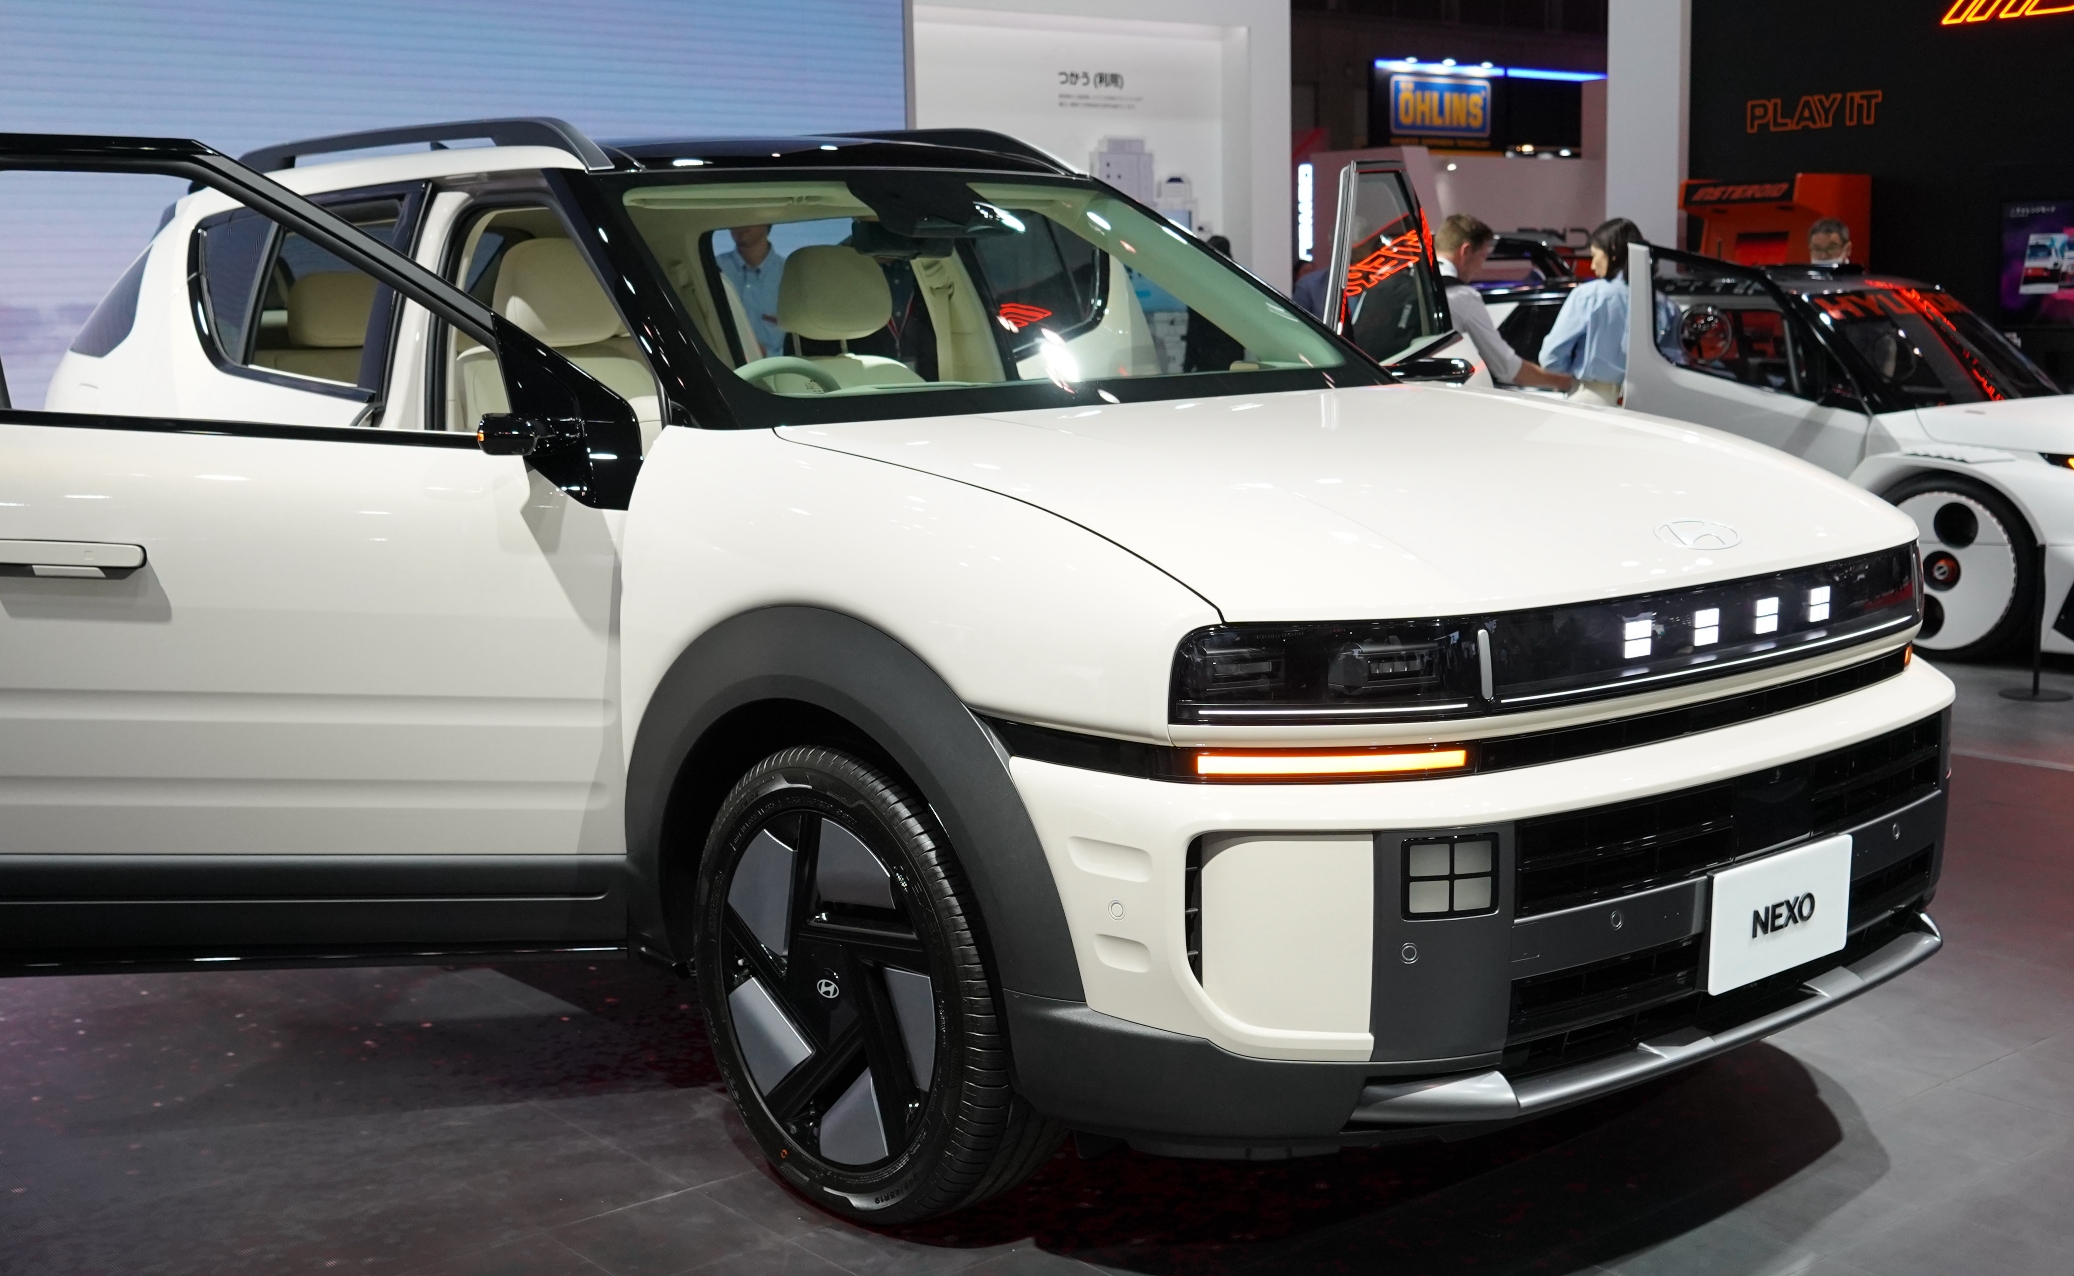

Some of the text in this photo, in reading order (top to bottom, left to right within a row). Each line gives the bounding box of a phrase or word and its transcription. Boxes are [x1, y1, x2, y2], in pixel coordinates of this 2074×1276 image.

[1058, 71, 1090, 86] つかう
[1398, 81, 1484, 128] ÖHLINS
[1747, 90, 1882, 133] PLAY IT
[1752, 892, 1815, 939] NEXO
